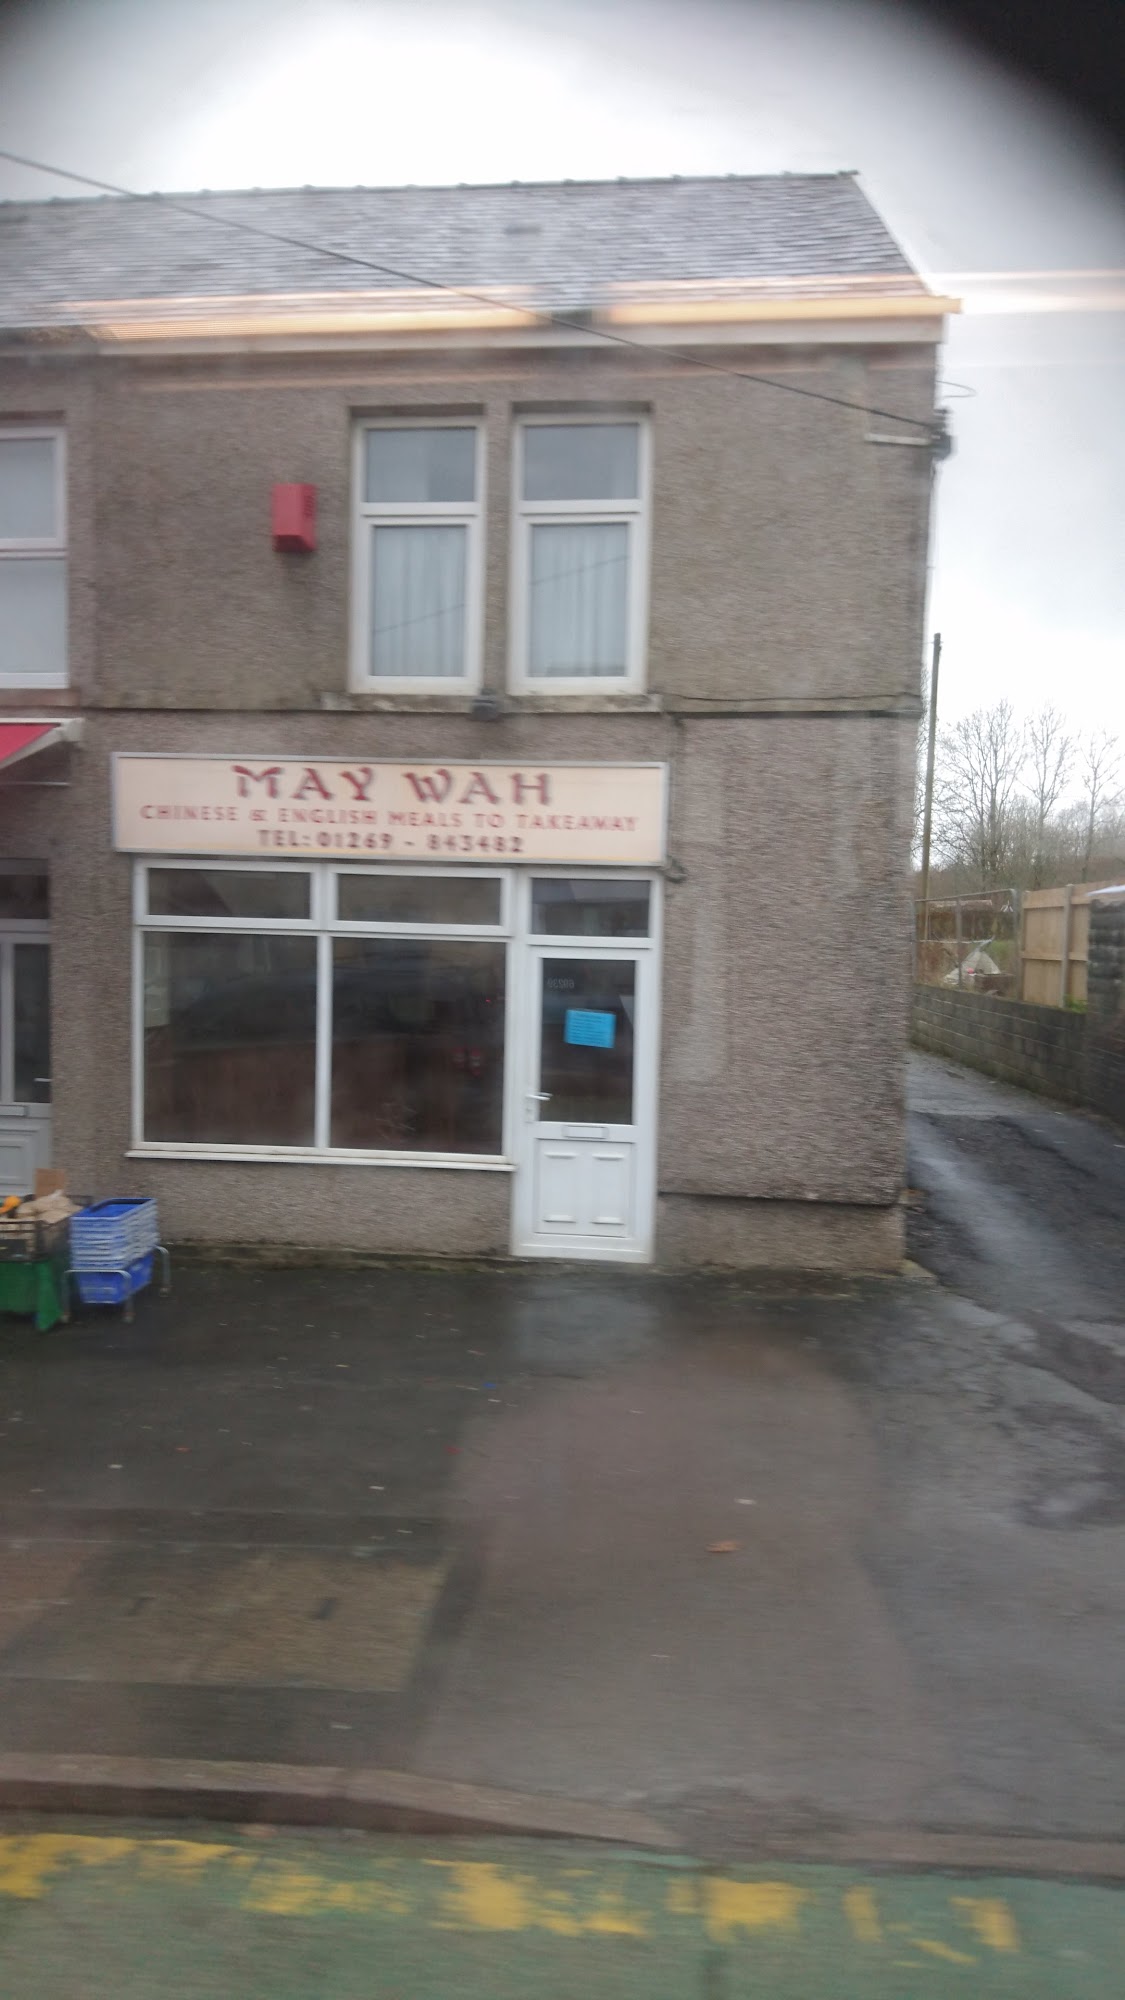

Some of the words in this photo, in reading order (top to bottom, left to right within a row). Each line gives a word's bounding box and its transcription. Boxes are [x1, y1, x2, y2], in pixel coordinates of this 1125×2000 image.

[231, 765, 374, 801] MAY
[401, 769, 552, 805] WAH
[140, 805, 239, 821] CHINESE
[250, 809, 267, 822] &
[278, 808, 377, 824] ENGLISH
[388, 811, 463, 827] MEALS
[473, 813, 505, 828] TO
[517, 814, 638, 831] TAKEAWAY
[427, 834, 524, 852] 843482
